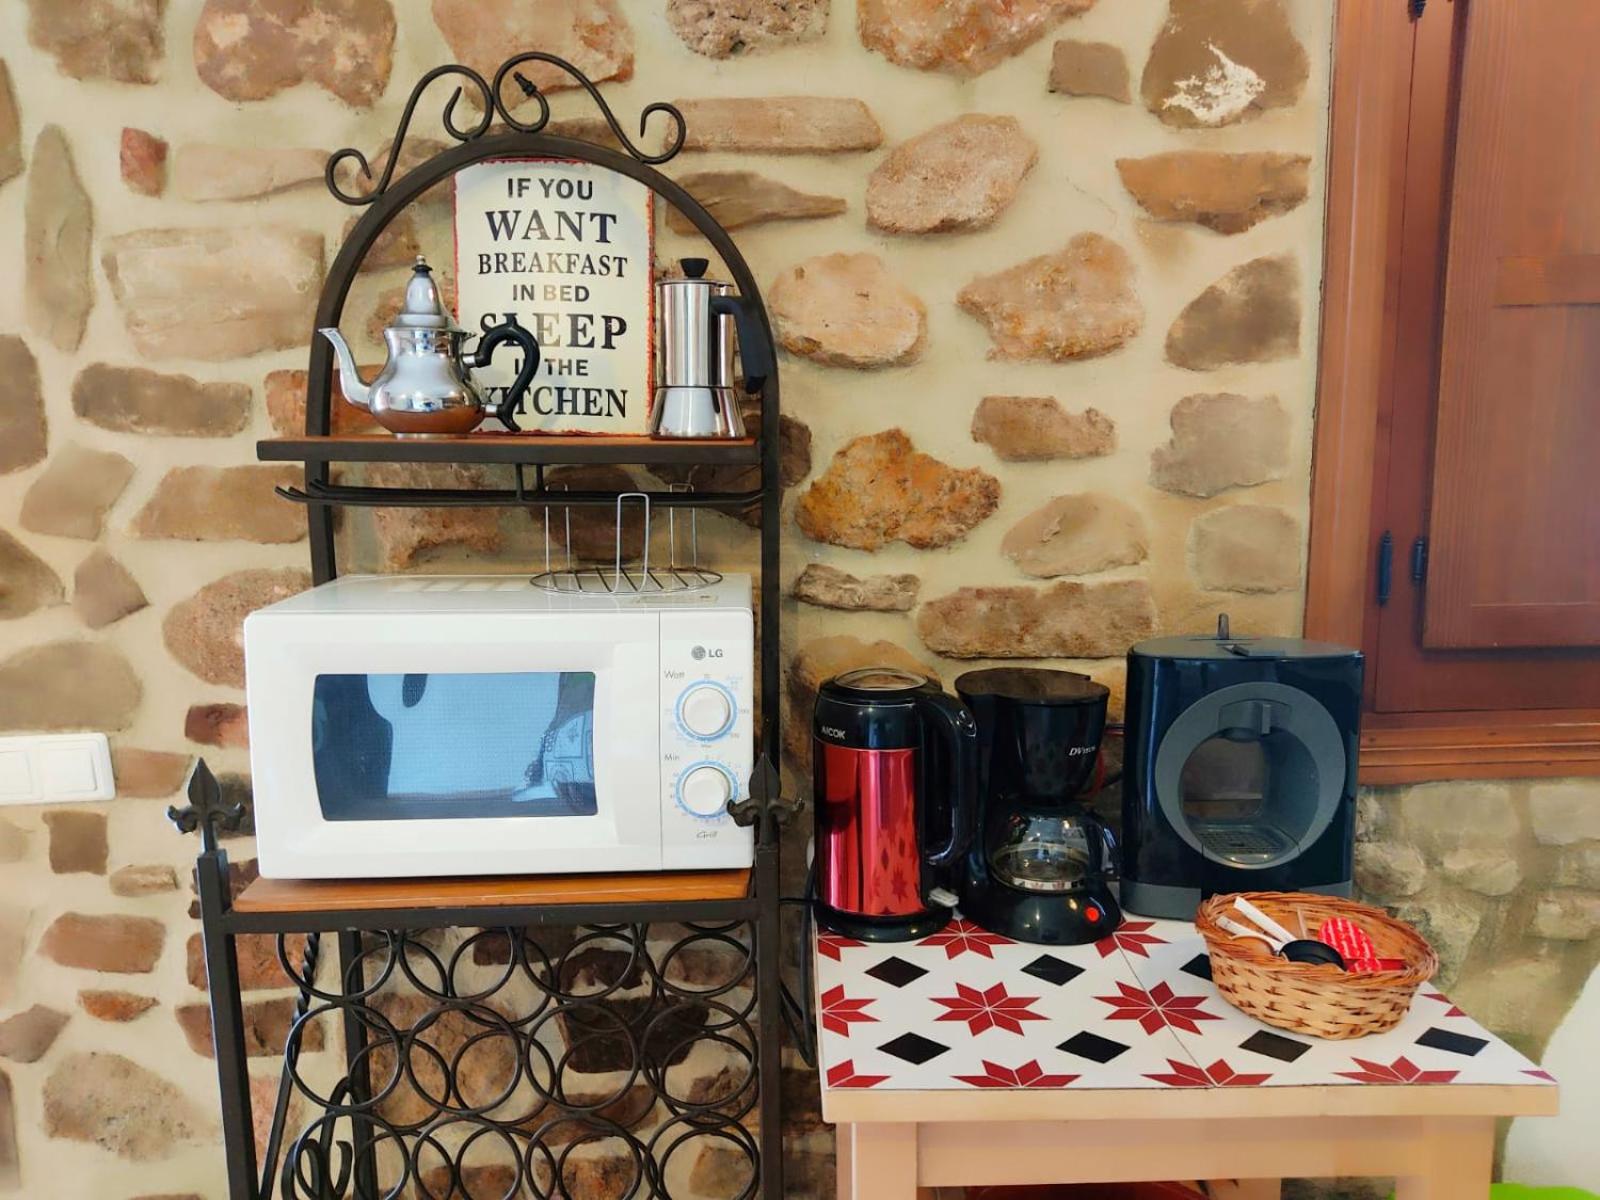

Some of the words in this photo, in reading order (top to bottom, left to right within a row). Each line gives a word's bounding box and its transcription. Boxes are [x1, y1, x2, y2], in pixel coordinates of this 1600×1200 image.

[508, 178, 531, 198] IF
[539, 178, 593, 200] YOU
[485, 209, 617, 243] WANT
[478, 252, 628, 277] BREAKFAST
[513, 284, 535, 301] IN
[543, 284, 590, 302] BED
[544, 358, 589, 376] THE
[708, 648, 724, 658] LG
[664, 670, 685, 679] Watt
[664, 752, 680, 760] Min
